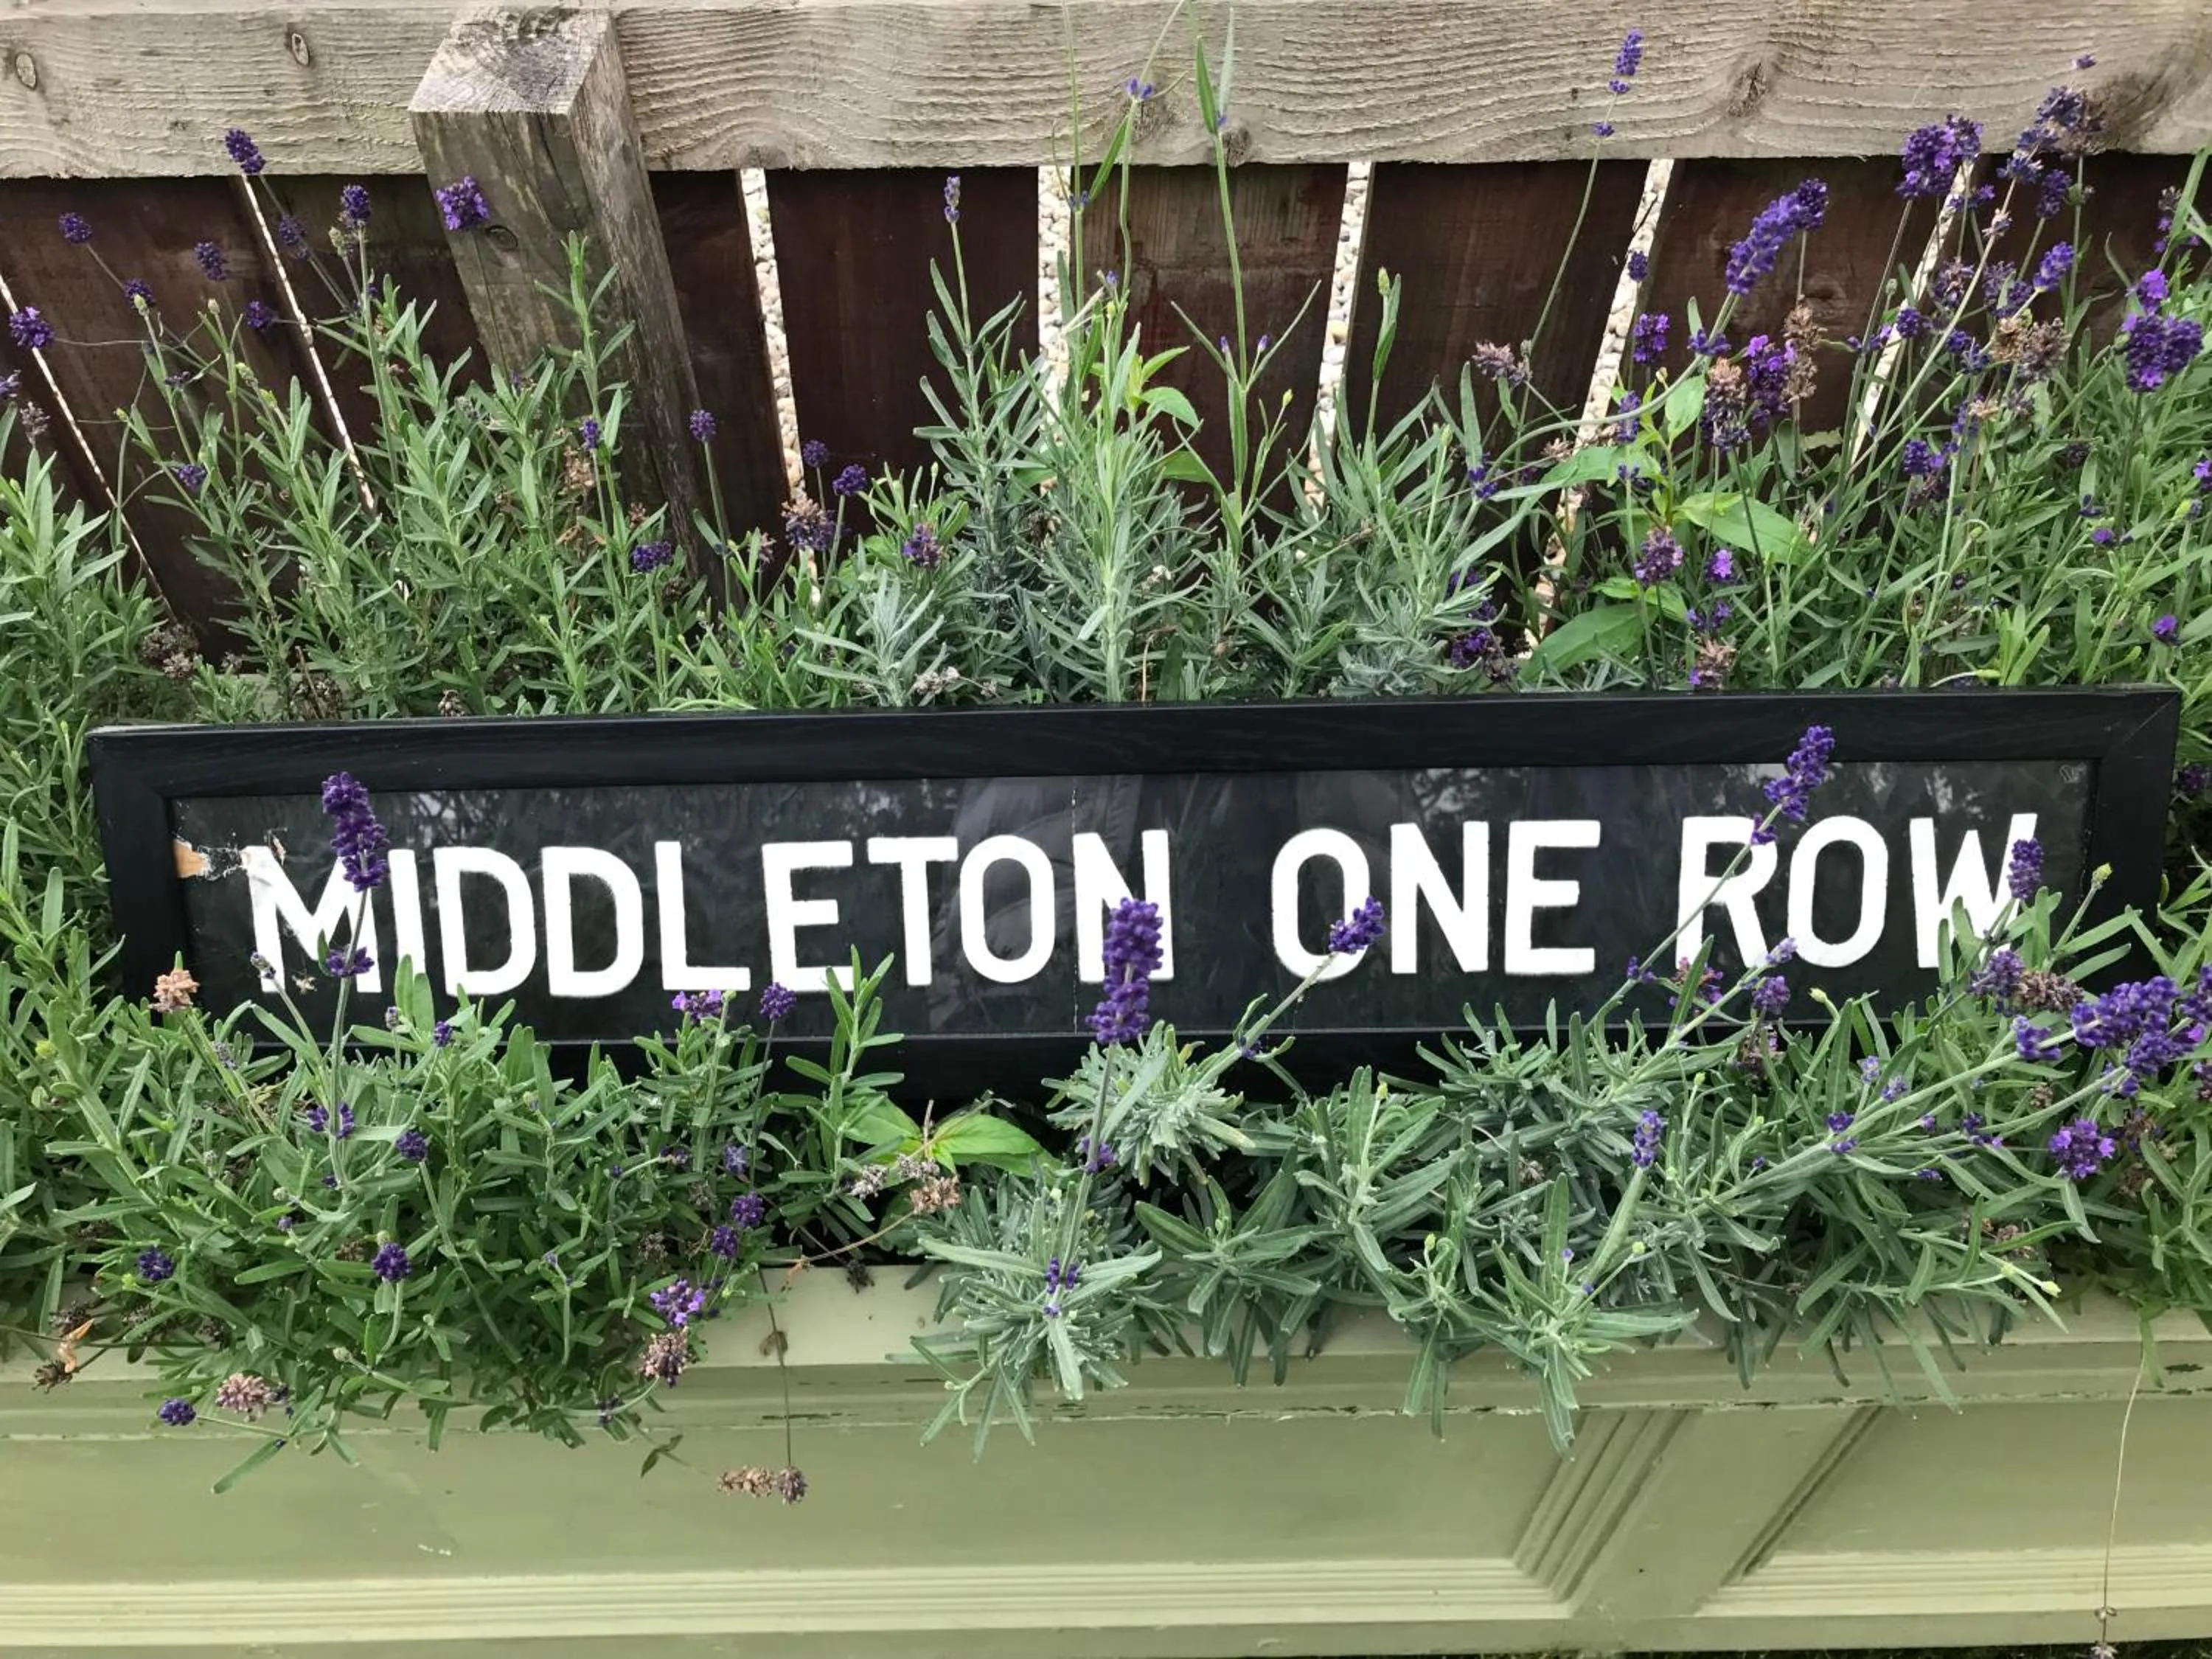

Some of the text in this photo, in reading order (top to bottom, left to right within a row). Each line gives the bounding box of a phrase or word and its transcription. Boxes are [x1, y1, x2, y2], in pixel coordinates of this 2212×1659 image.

[242, 813, 2038, 998] MIDDLETON ONE ROW
